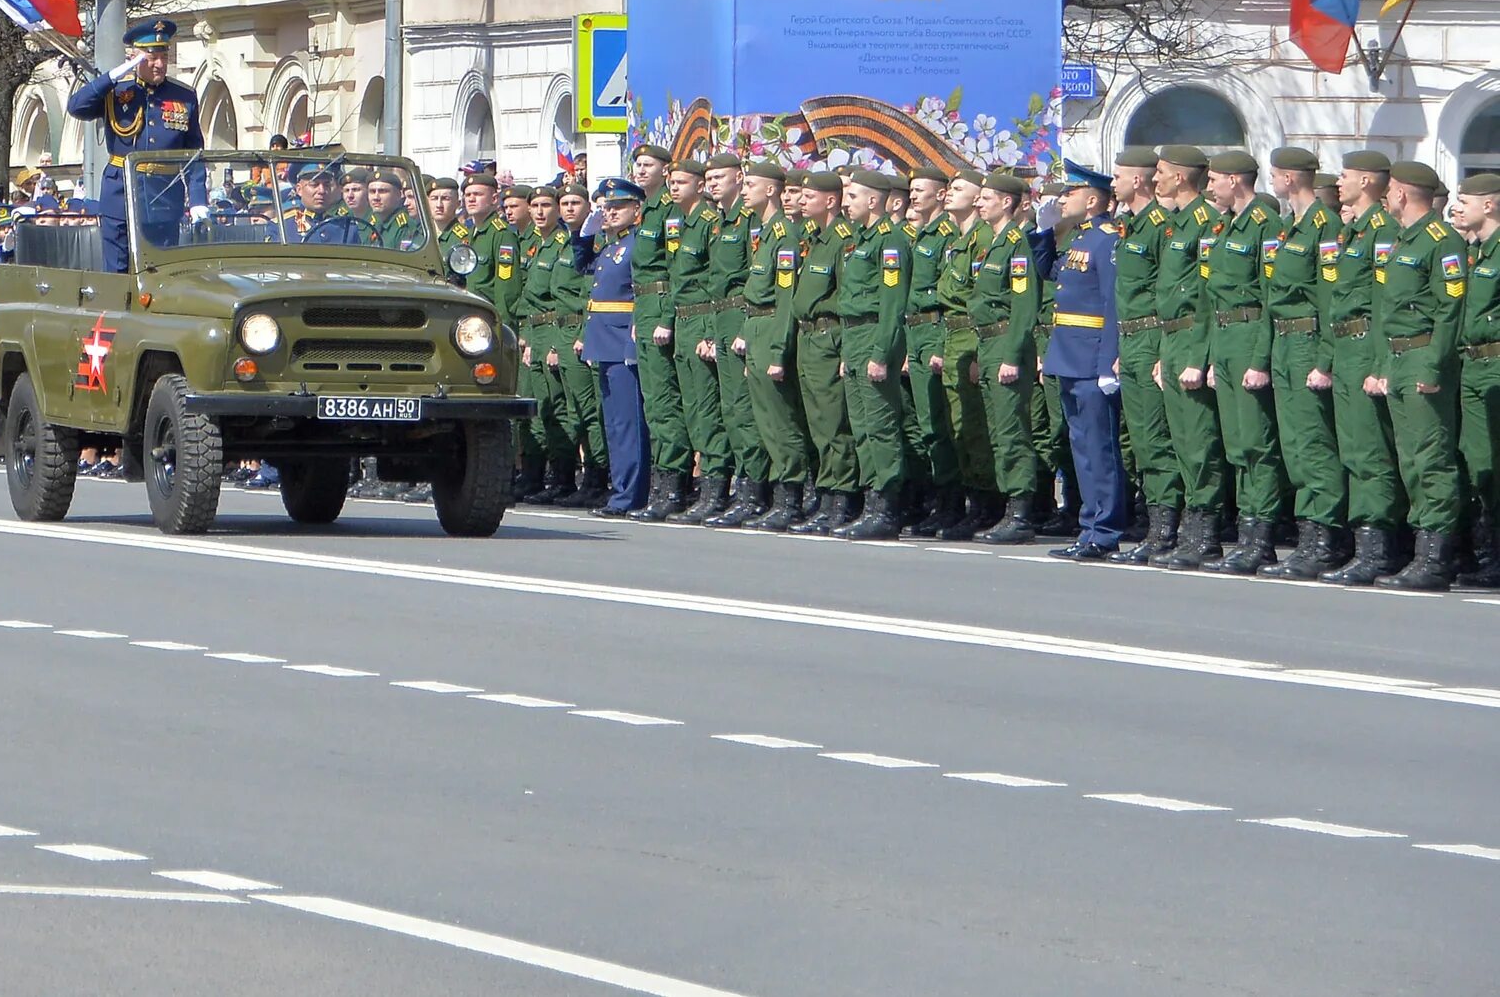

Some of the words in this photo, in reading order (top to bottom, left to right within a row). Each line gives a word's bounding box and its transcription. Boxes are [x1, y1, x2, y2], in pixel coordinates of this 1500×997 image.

[790, 14, 816, 25] Герой
[819, 14, 870, 25] Советского
[905, 15, 941, 26] Маршал
[943, 15, 994, 26] Советского
[783, 27, 832, 37] Начальник
[834, 27, 895, 38] Генерального
[897, 28, 923, 37] штаба
[989, 30, 1005, 39] сил
[807, 39, 866, 50] Выдающийся
[914, 42, 939, 51] автор
[940, 42, 1010, 51] стратегической
[858, 65, 896, 75] Родился
[325, 399, 368, 417] 8386
[371, 403, 393, 418] АН
[397, 399, 415, 413] 50
